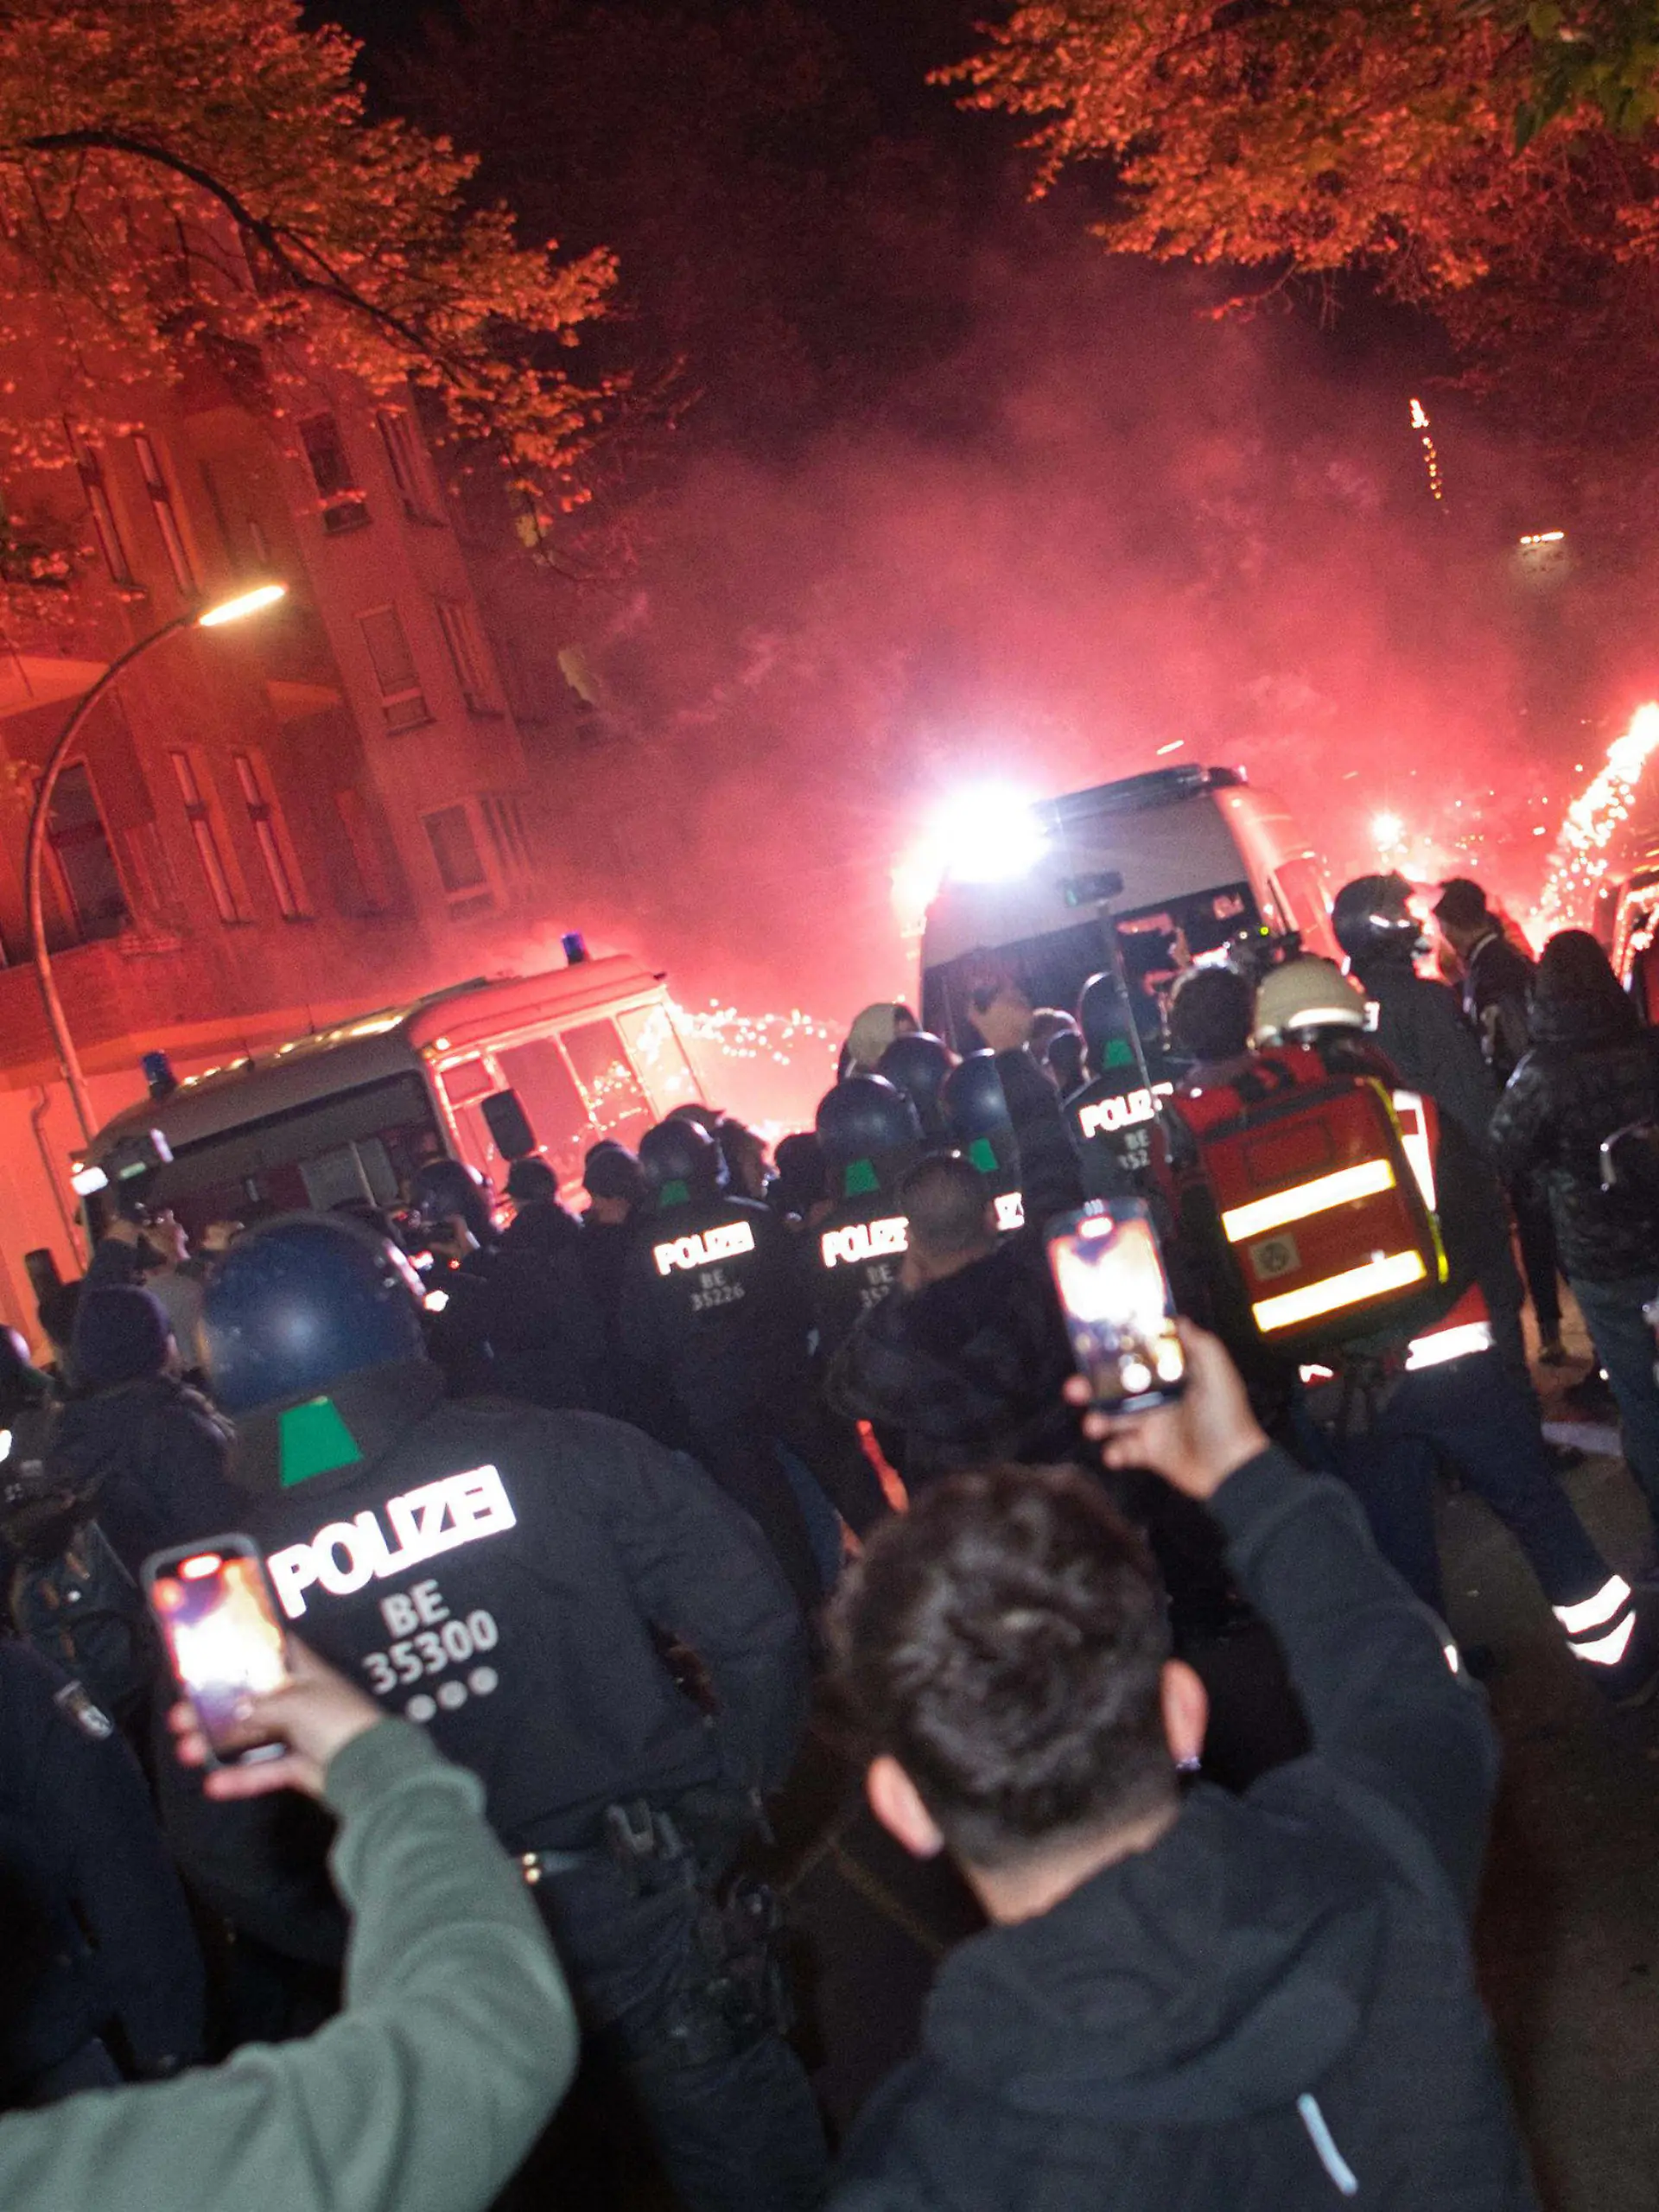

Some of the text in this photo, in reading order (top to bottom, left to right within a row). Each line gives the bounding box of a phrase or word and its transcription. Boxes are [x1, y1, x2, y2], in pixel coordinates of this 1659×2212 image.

[1079, 1081, 1173, 1138] POLIZ
[653, 1220, 755, 1275] POLIZEI
[821, 1216, 909, 1268] POLIZE
[701, 1268, 726, 1289] BE
[867, 1263, 893, 1285] BE
[265, 1464, 517, 1620] POLIZEI
[380, 1579, 450, 1638] BE
[362, 1609, 499, 1694] 35300
